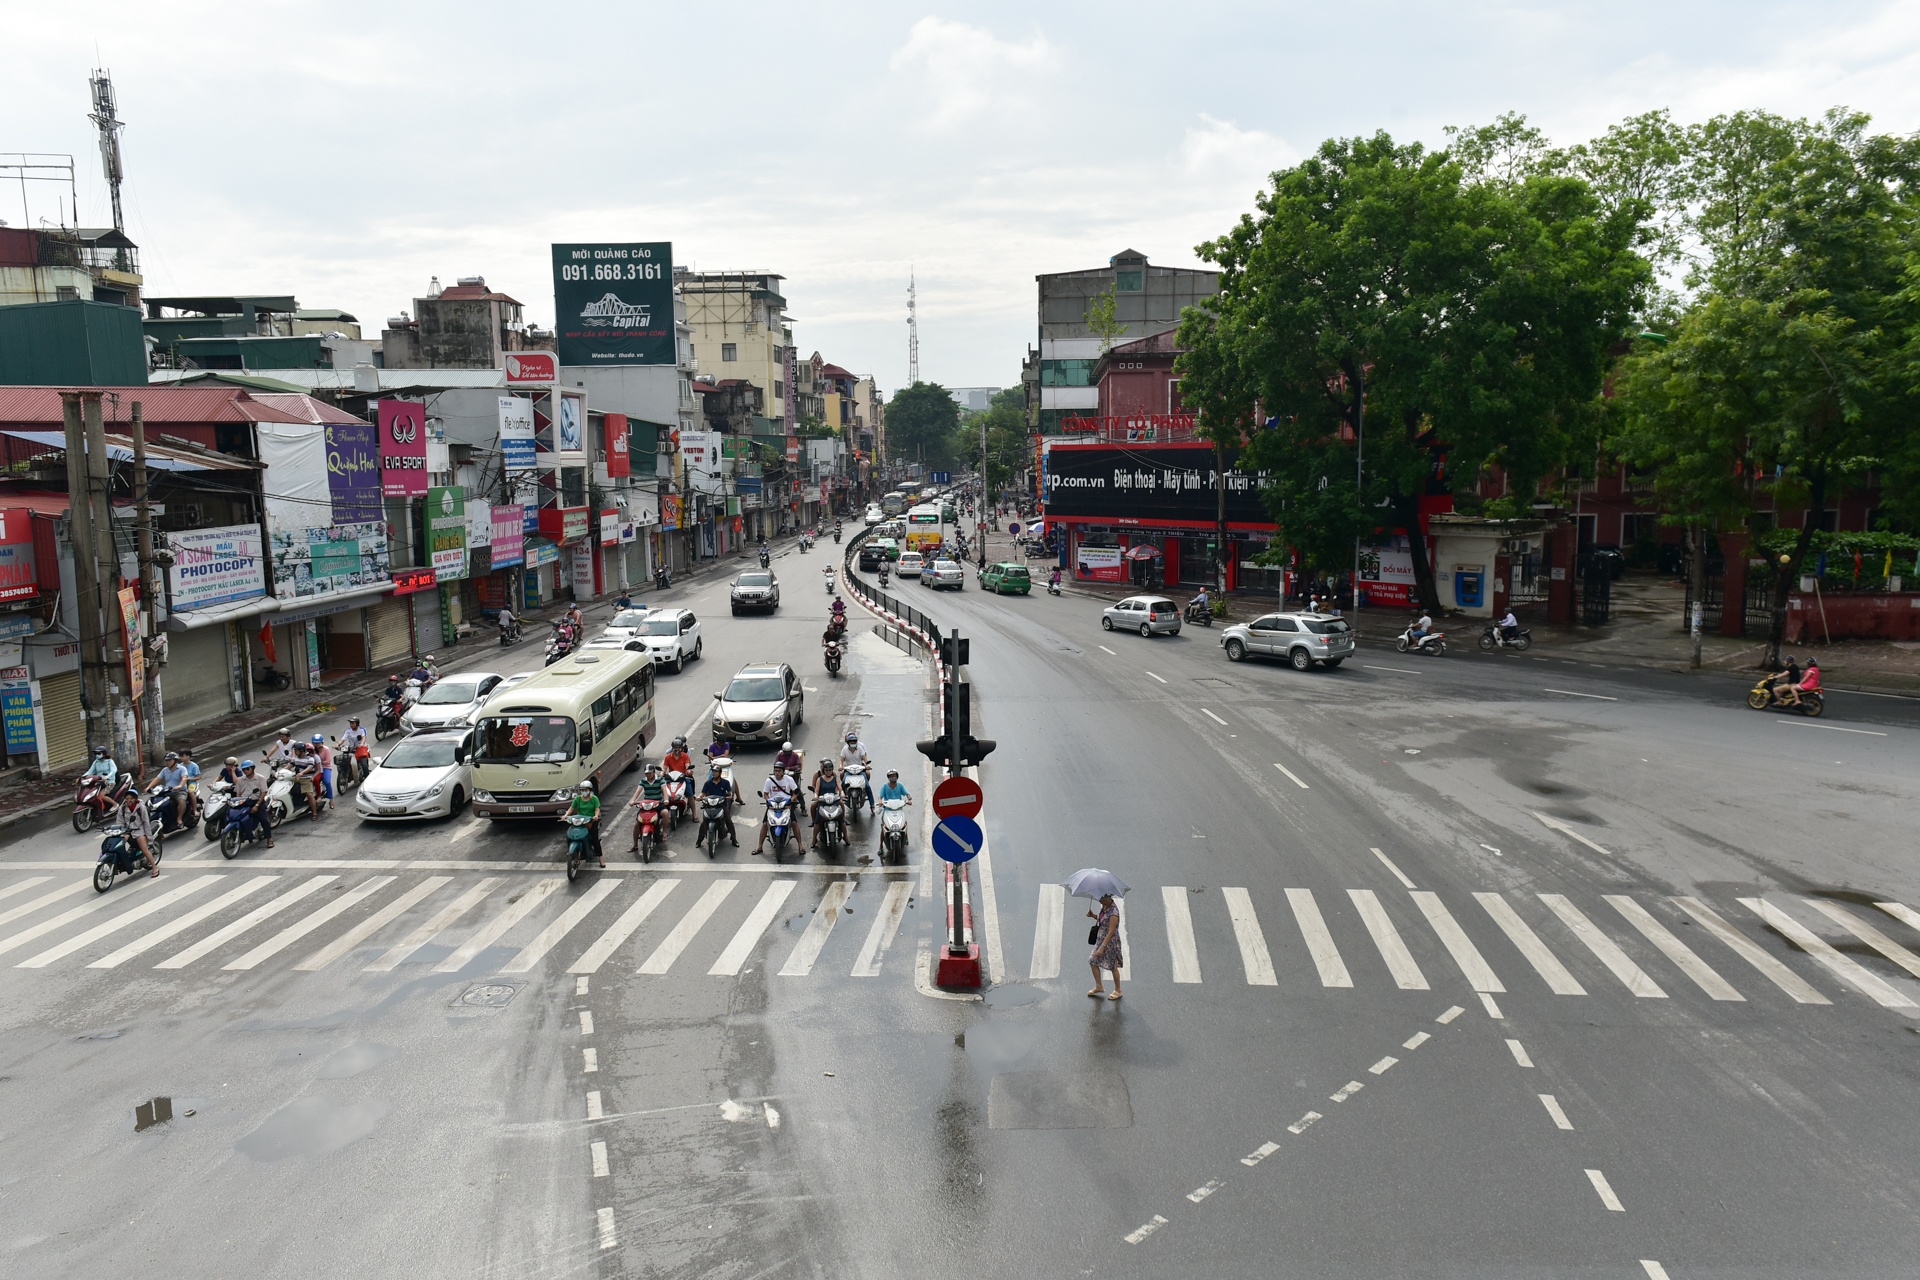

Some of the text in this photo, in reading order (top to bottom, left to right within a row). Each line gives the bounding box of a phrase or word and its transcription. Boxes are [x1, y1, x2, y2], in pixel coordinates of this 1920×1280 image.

[572, 248, 651, 260] MỜI QUẢNG CÁO
[562, 264, 661, 281] 091.668.3161
[612, 315, 650, 329] Capital
[1061, 412, 1100, 432] CÔNG
[1104, 416, 1122, 430] TY
[1126, 404, 1147, 430] CỔ
[1130, 428, 1155, 440] FPT
[360, 452, 375, 472] Hoa
[385, 456, 426, 469] EVA SPORT
[1114, 469, 1131, 493] Điện
[1135, 469, 1156, 493] thoại
[1164, 469, 1181, 494] Máy
[1184, 469, 1200, 489] tính
[1228, 470, 1248, 495] kiện
[188, 546, 212, 564] SCAN
[215, 551, 237, 560] LASER
[181, 558, 254, 578] PHOTOCOPY
[1383, 564, 1412, 574] ĐỔI MÁY
[0, 587, 33, 597] 38574082
[188, 584, 217, 595] PHOTOCOPY
[1, 668, 27, 678] MAX
[9, 697, 26, 705] VĂN
[5, 706, 32, 717] PHÒNG
[8, 716, 32, 727] PHẨM
